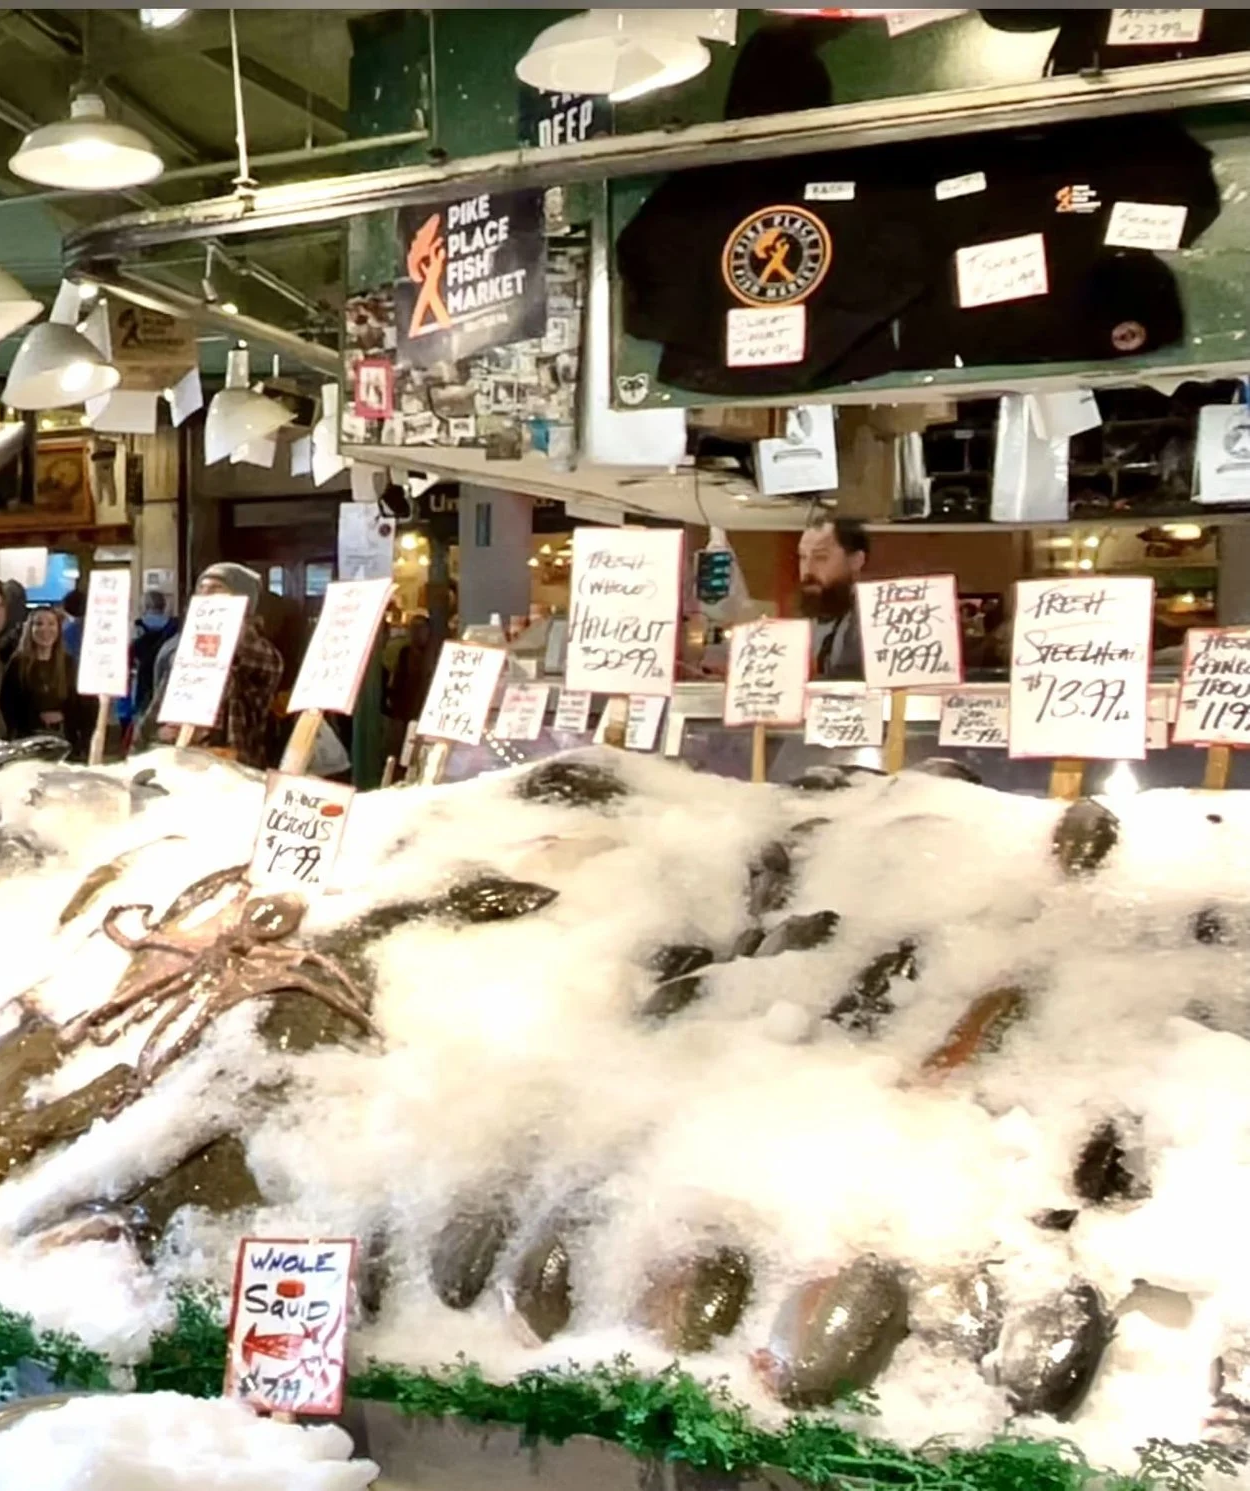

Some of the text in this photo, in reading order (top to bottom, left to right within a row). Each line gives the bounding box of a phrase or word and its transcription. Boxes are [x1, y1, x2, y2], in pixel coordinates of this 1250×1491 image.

[538, 100, 593, 149] DEEP
[447, 194, 491, 229] PIKE
[447, 217, 510, 257] PLACE
[446, 246, 500, 288] FISH
[447, 269, 527, 313] MARKET
[1024, 585, 1116, 619] FRESH
[568, 602, 674, 644] HALIBUT
[884, 624, 932, 645] COD
[251, 1248, 336, 1273] WHOLE
[245, 1284, 331, 1321] SQUID
